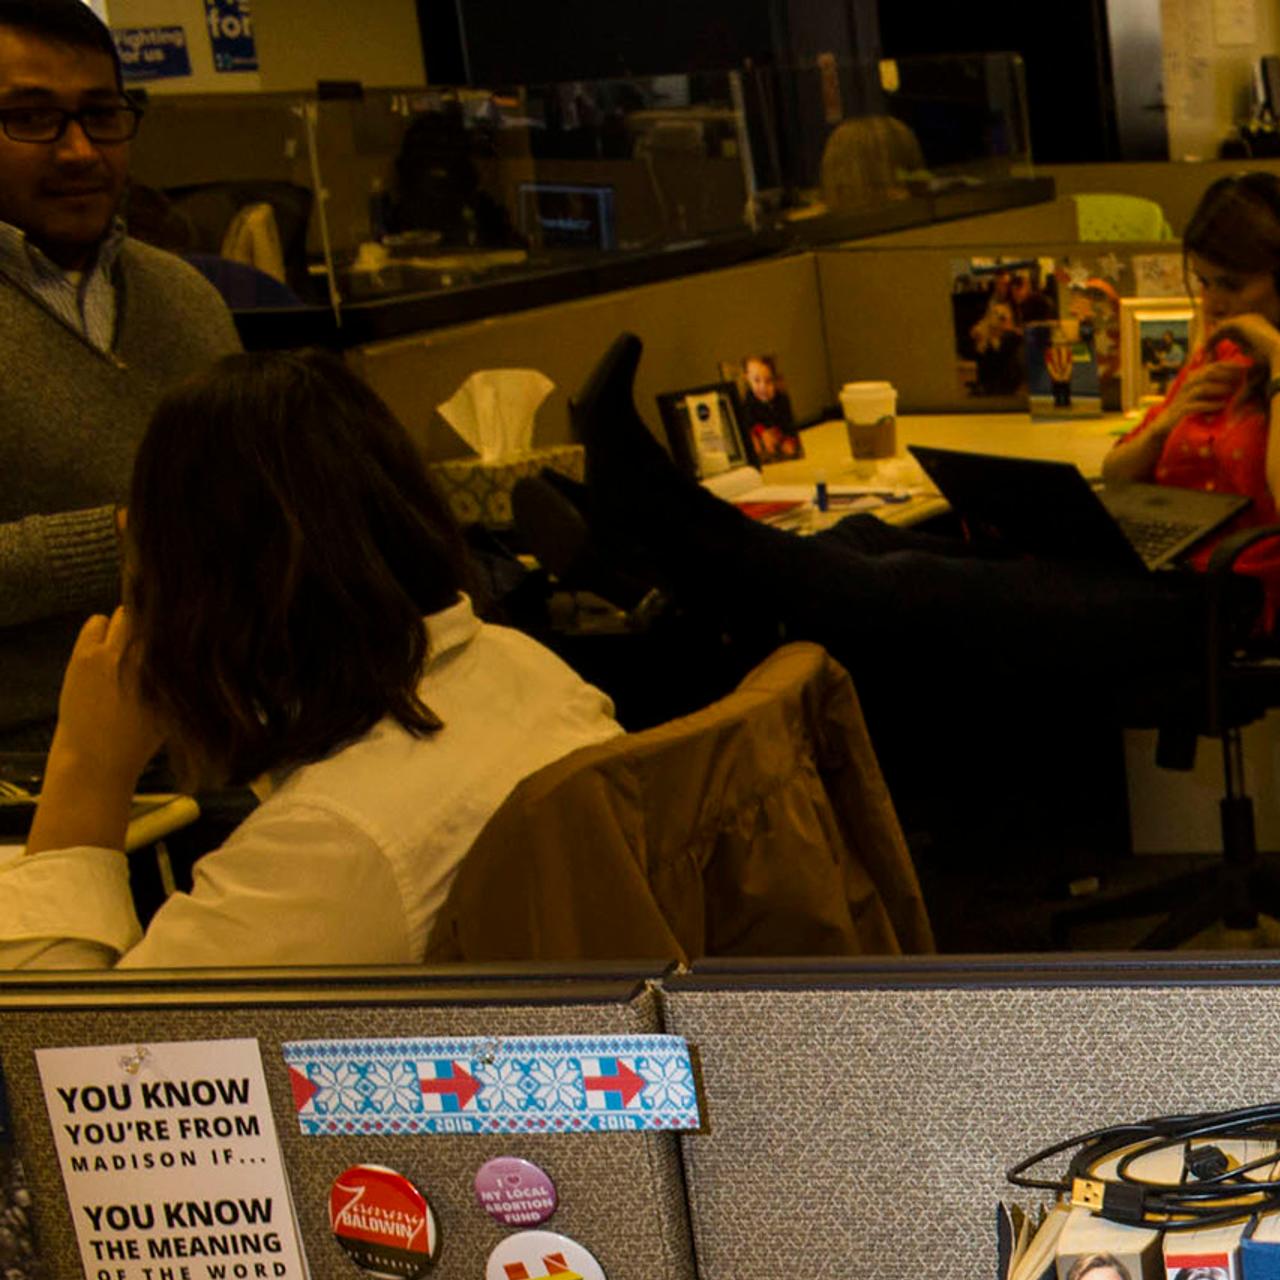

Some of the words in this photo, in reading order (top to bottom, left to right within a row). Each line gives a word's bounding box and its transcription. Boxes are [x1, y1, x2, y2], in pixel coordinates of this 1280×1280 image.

[57, 1084, 132, 1113] YOU
[142, 1078, 250, 1109] KNOW
[65, 1119, 170, 1145] YOU'RE
[179, 1115, 260, 1140] FROM
[436, 1115, 473, 1133] 2016
[599, 1114, 636, 1131] 2016
[72, 1151, 197, 1172] MADISON
[212, 1149, 266, 1165] IF...
[481, 1189, 502, 1201] MY
[505, 1186, 549, 1199] LOCAL
[84, 1204, 155, 1232] YOU
[164, 1198, 273, 1229] KNOW
[484, 1198, 553, 1213] ABORTION
[340, 1212, 415, 1239] BALDWIN
[504, 1212, 541, 1223] FUND
[90, 1239, 141, 1261] THE
[147, 1232, 282, 1258] MEANING
[207, 1261, 287, 1280] WORD
